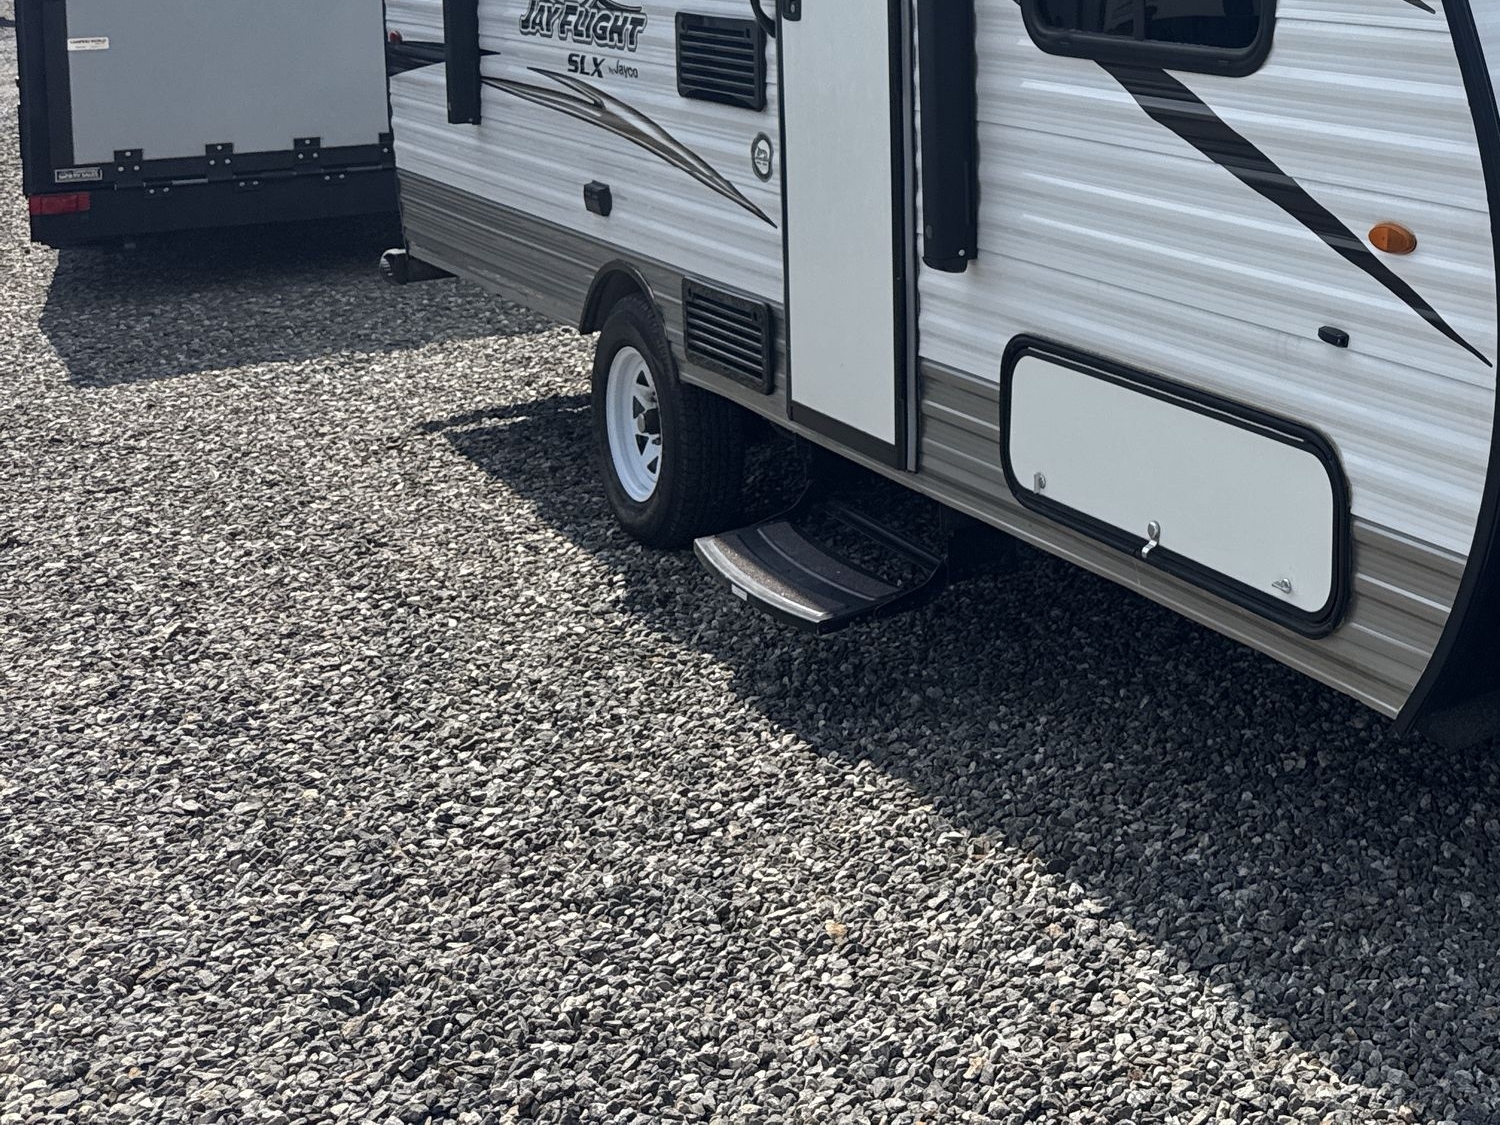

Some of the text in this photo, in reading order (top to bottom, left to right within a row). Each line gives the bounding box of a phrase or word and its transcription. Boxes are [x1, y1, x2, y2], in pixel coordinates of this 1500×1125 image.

[558, 0, 648, 52] FLIGHT
[567, 53, 605, 78] SLX
[614, 59, 639, 78] Jayco
